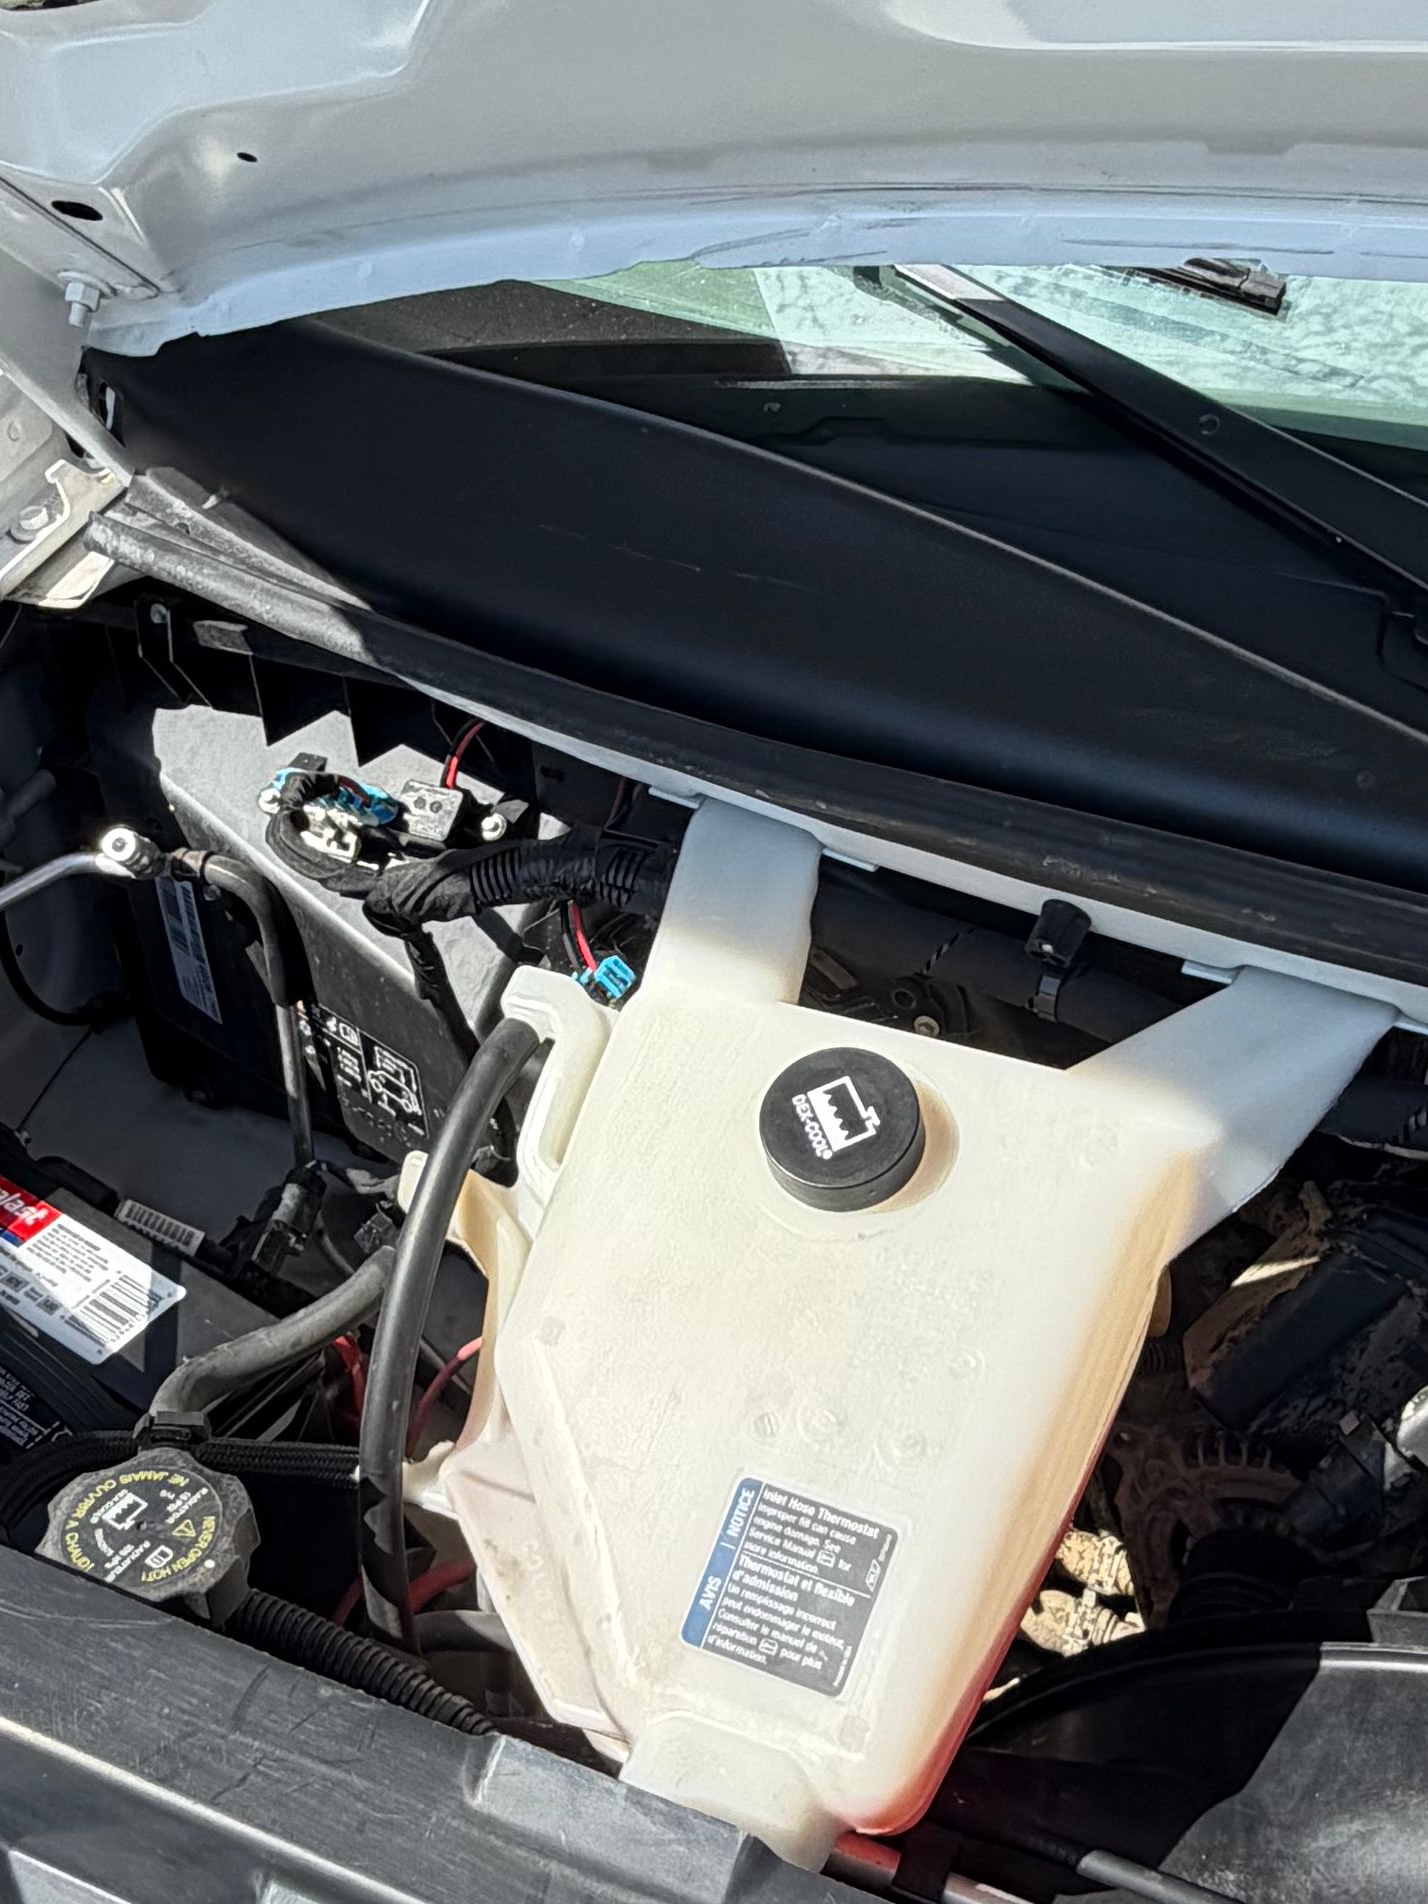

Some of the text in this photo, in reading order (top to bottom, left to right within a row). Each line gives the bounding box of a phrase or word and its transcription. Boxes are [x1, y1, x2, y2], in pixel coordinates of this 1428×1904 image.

[120, 1470, 169, 1484] JAMAIS
[726, 1488, 755, 1538] NOTICE
[761, 1487, 880, 1538] Inlet Hose Thermostat
[747, 1527, 781, 1546] Service
[781, 1538, 816, 1558] Manual
[810, 1522, 829, 1535] can
[828, 1528, 856, 1545] cause
[822, 1538, 842, 1553] See
[172, 1548, 202, 1572] OPEN
[737, 1555, 800, 1586] Thermostat
[141, 1568, 172, 1582] HOT!
[699, 1575, 722, 1610] AVIS
[716, 1607, 760, 1631] Consulter
[769, 1628, 805, 1648] manuel
[804, 1640, 818, 1653] de
[794, 1607, 837, 1630] incorrect
